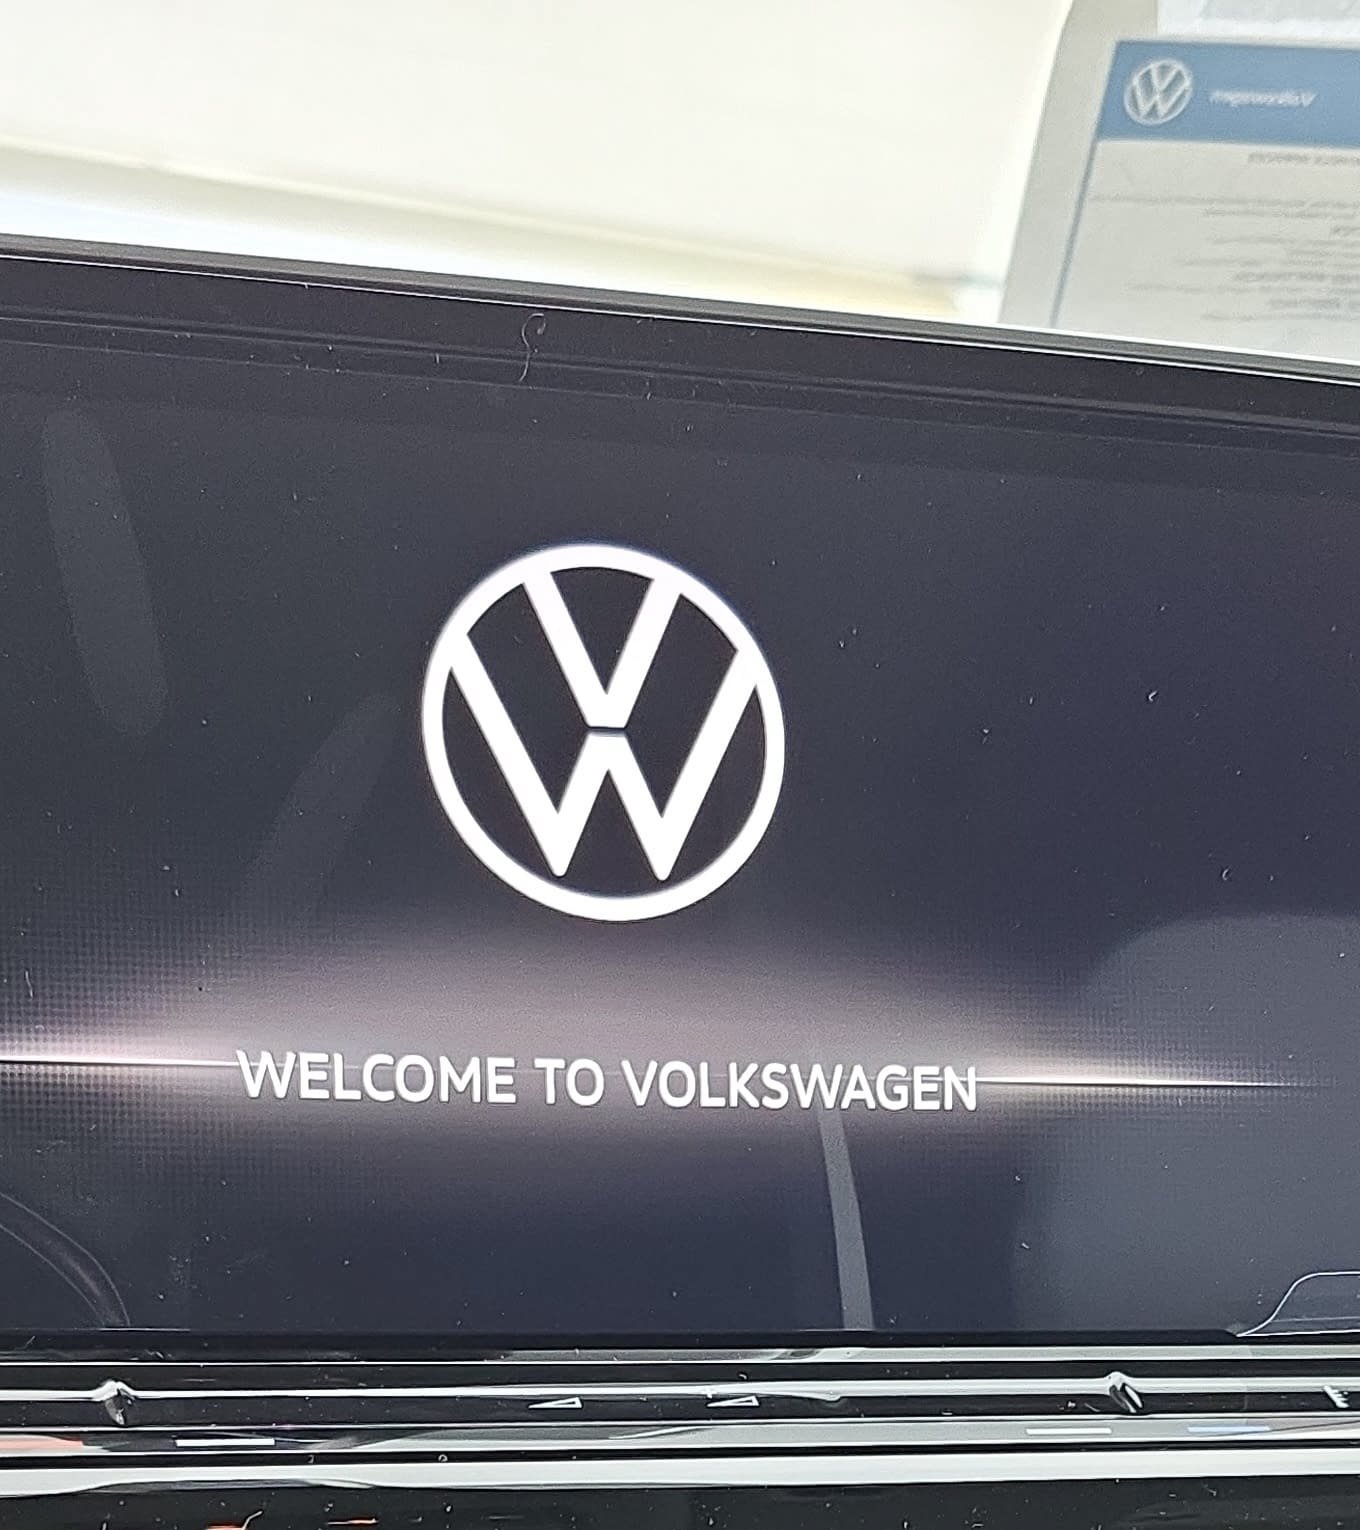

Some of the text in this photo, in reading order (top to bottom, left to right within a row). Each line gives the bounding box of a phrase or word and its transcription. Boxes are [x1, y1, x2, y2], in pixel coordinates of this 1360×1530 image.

[235, 1049, 979, 1112] WELCOME TO VOLKSWAGEN
